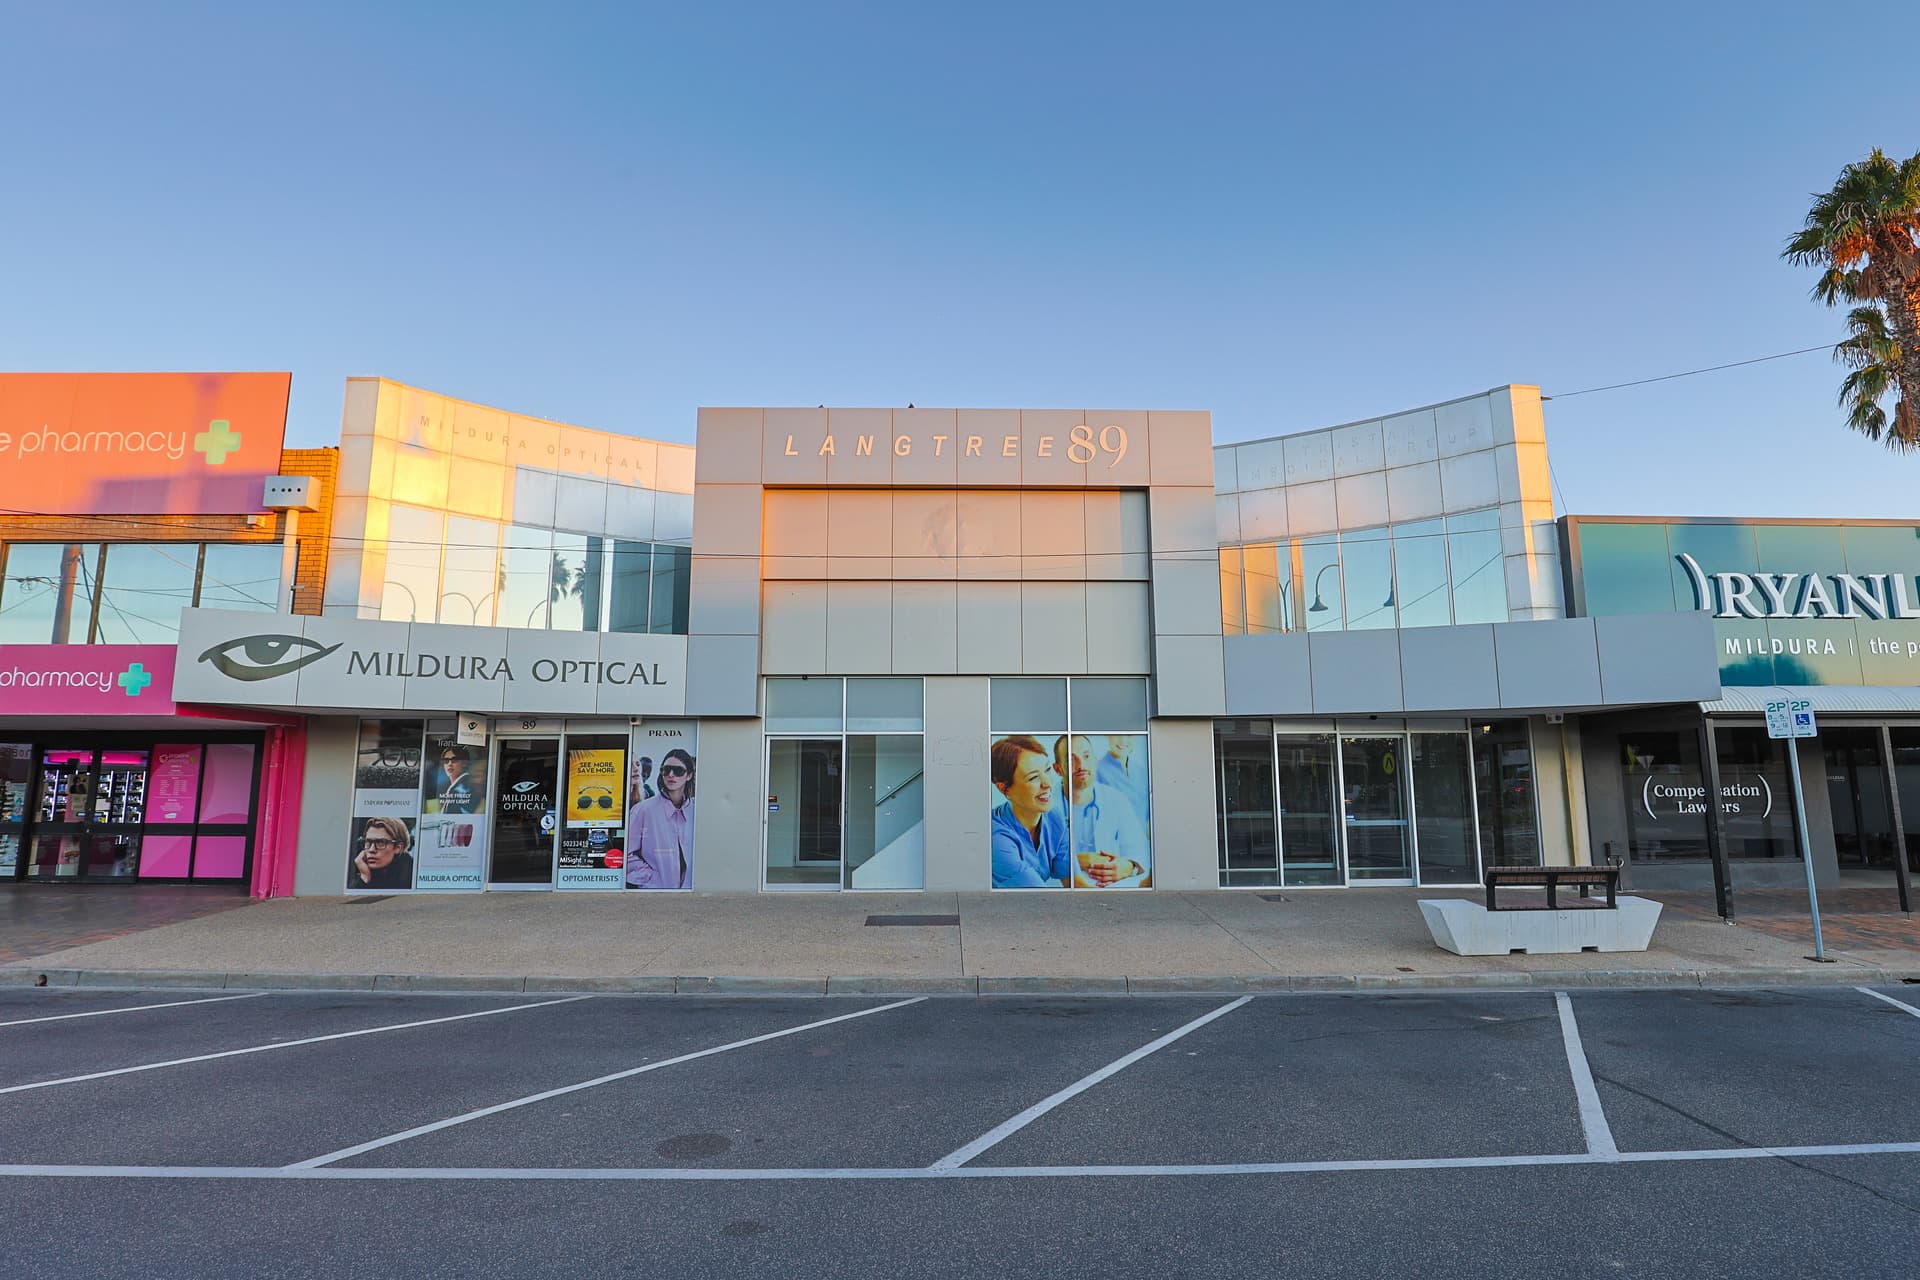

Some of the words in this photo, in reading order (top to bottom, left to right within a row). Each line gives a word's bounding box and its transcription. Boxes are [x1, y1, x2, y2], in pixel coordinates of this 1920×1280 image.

[18, 424, 187, 460] pharmacy
[420, 415, 527, 449] MILDURA
[547, 445, 642, 469] OPTICAL
[784, 435, 1054, 457] LANGTREE
[1067, 424, 1129, 470] 89
[1725, 638, 1837, 655] MILDURA
[1869, 637, 1900, 654] the
[346, 651, 514, 681] MILDURA
[532, 659, 667, 685] OPTICAL
[1767, 702, 1786, 712] 2P
[1790, 701, 1810, 711] 2P
[522, 720, 536, 729] 89
[502, 794, 548, 802] MILDURA
